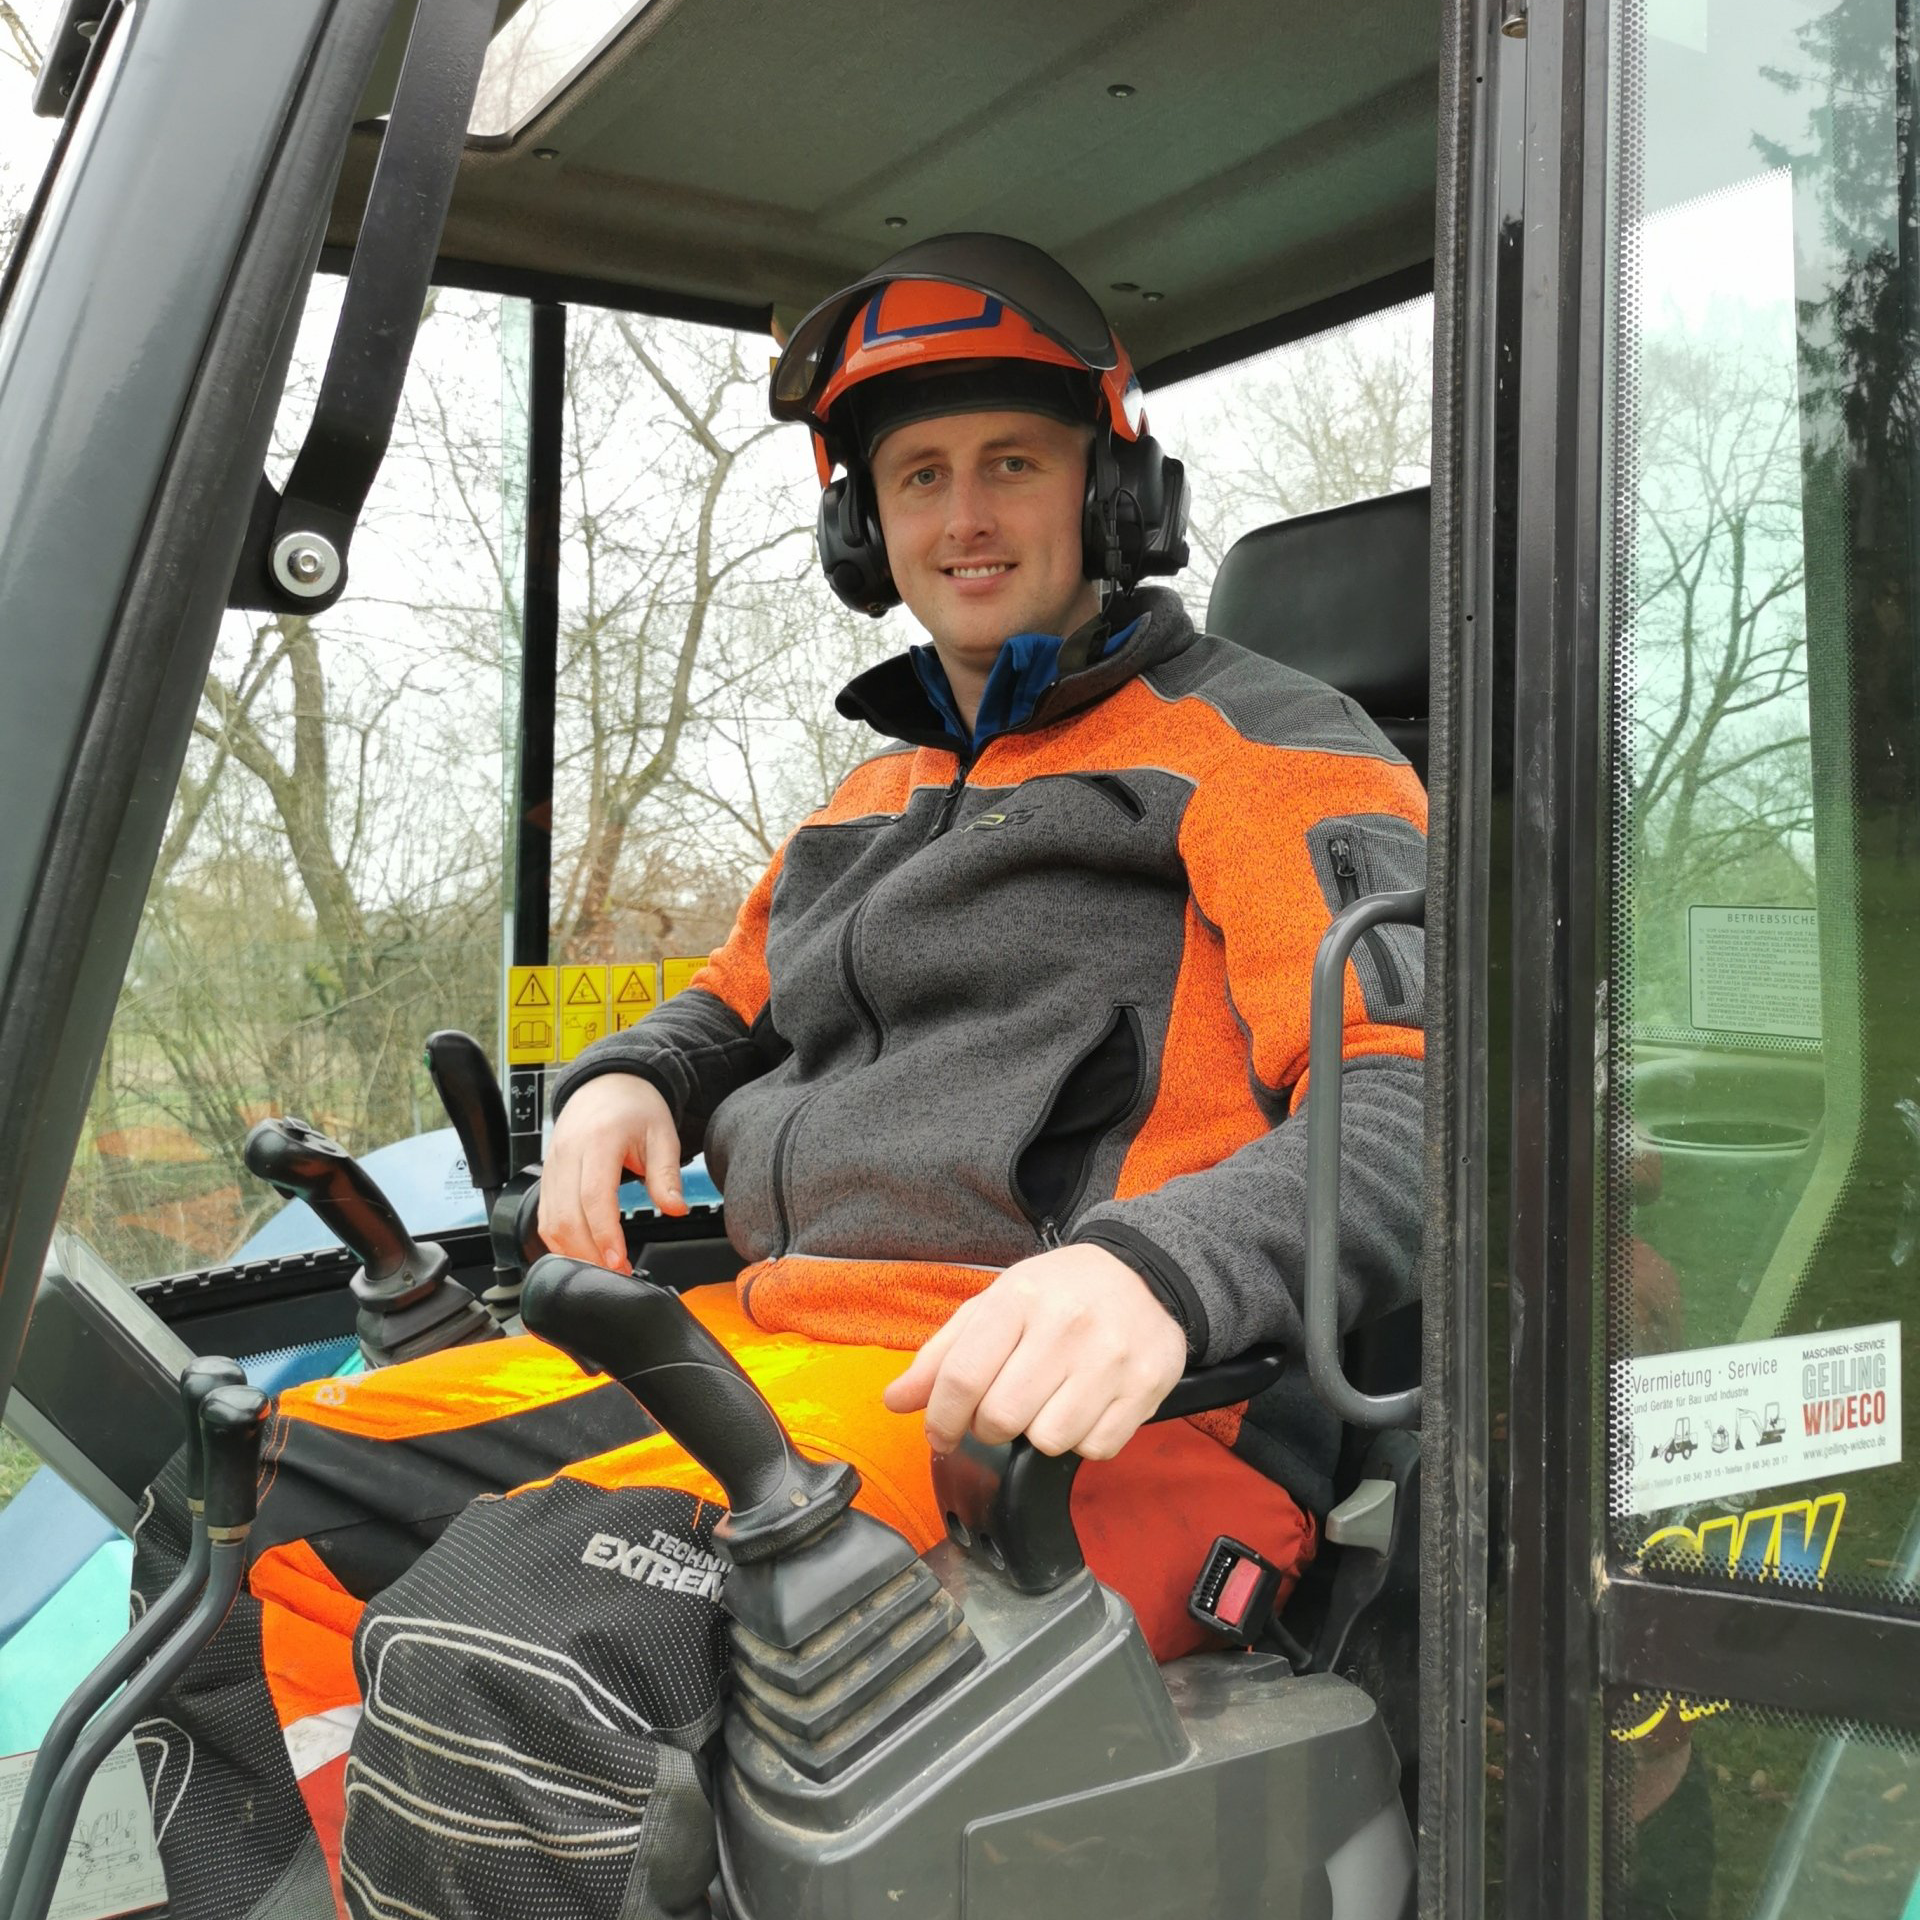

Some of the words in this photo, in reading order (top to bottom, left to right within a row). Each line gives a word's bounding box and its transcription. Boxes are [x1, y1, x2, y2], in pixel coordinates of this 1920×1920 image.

[1631, 1368, 1711, 1395] Vermietung
[1728, 1358, 1778, 1380] Service
[1802, 1353, 1886, 1400] GEILING
[1633, 1402, 1647, 1414] und
[1650, 1399, 1673, 1411] Geräte
[1676, 1396, 1685, 1407] für
[1689, 1394, 1702, 1405] Bau
[1704, 1391, 1717, 1402] und
[1720, 1387, 1749, 1400] Industrie
[1803, 1390, 1886, 1437] WIDECO
